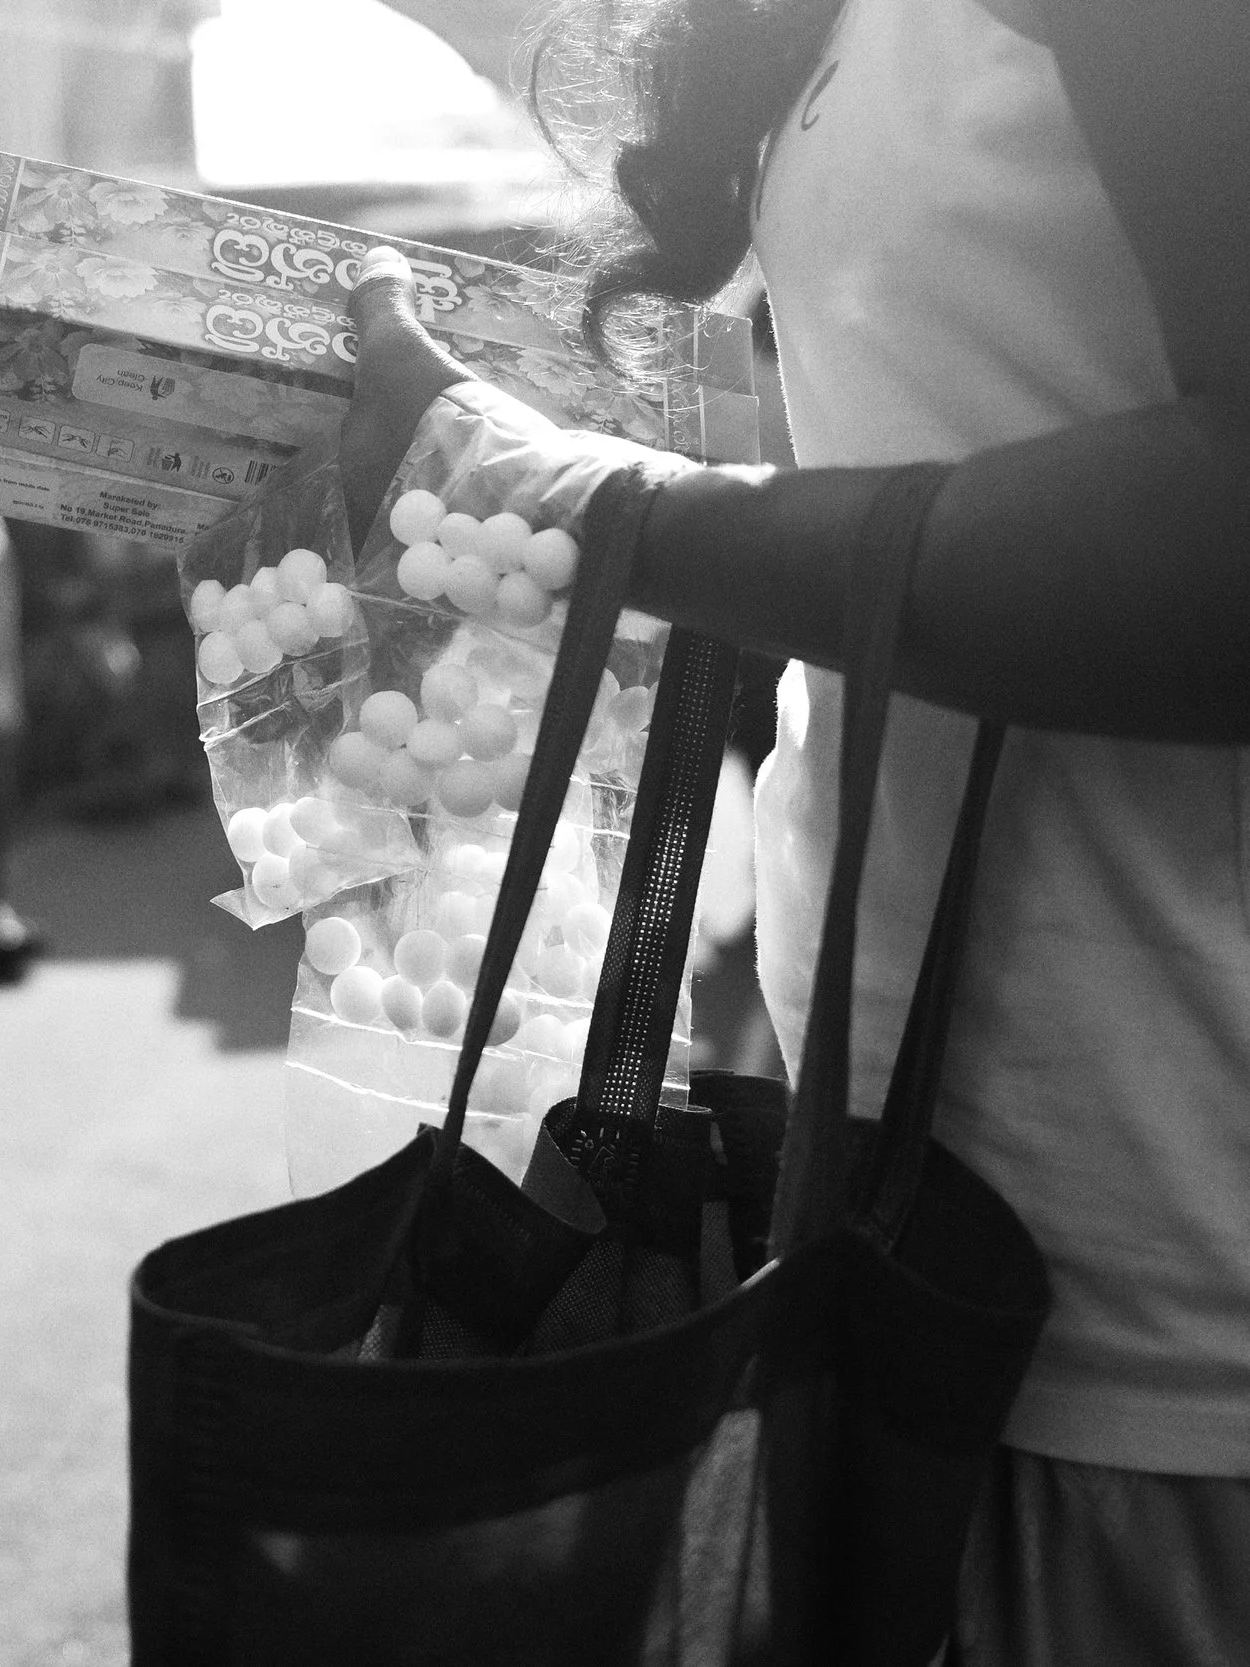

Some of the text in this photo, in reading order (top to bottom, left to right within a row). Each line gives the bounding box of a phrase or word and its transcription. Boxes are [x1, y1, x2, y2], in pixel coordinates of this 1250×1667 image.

[116, 369, 146, 383] Clean
[60, 504, 73, 512] No
[103, 502, 130, 514] Super
